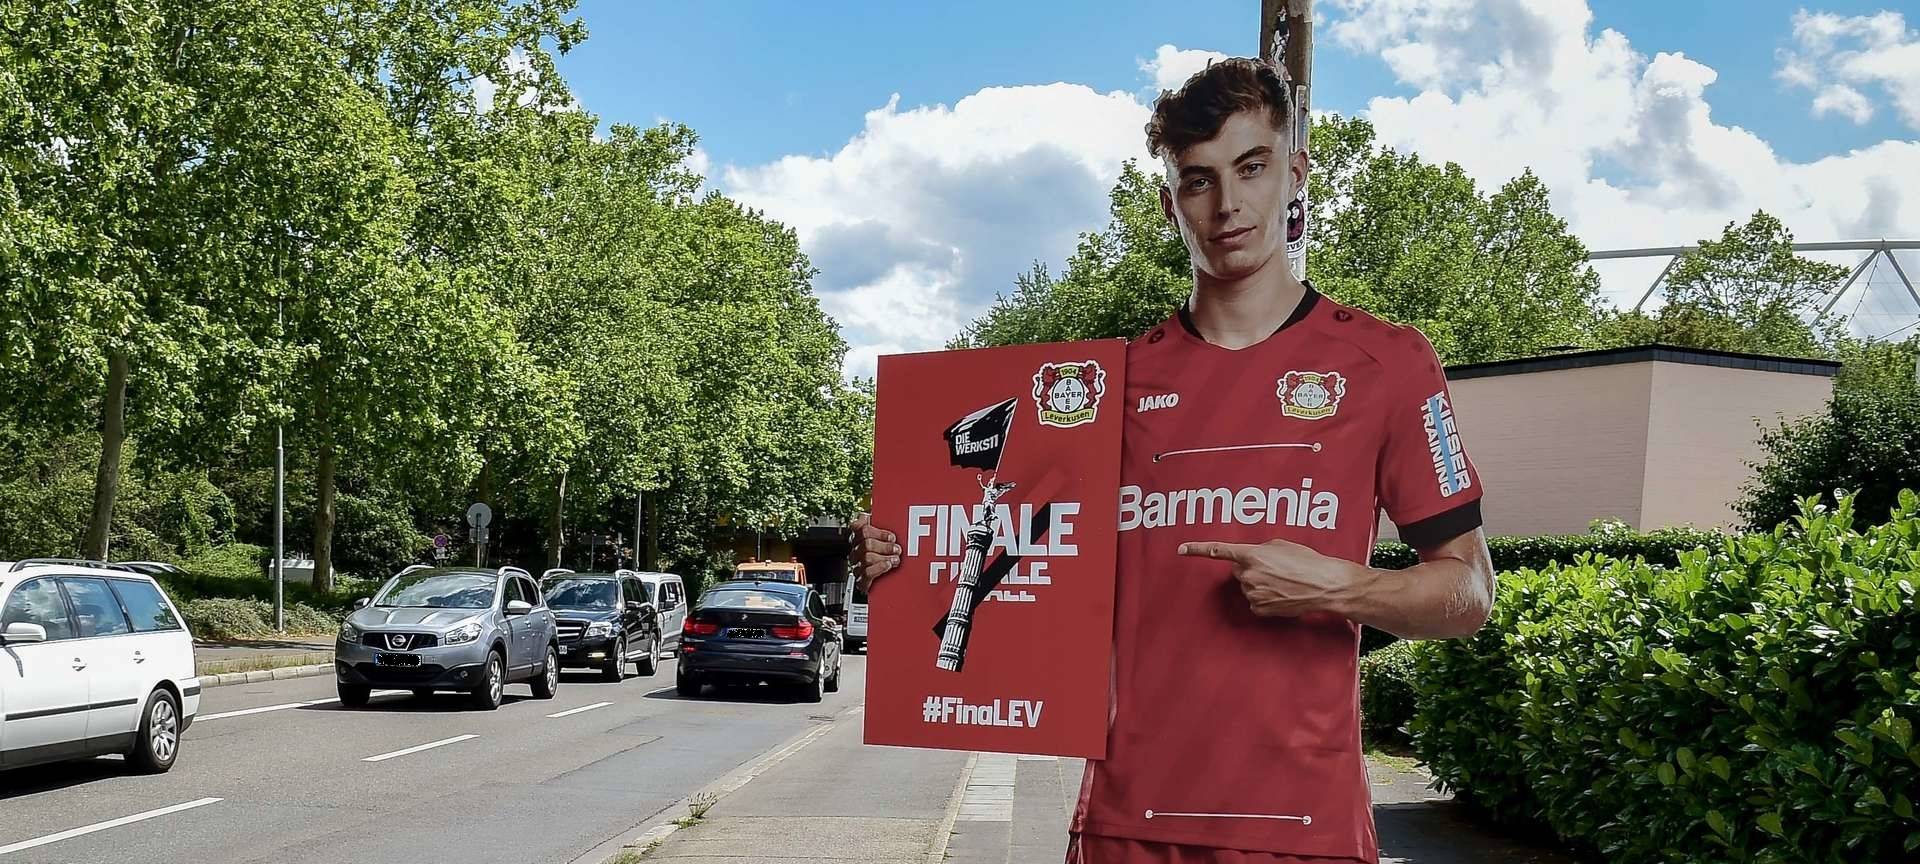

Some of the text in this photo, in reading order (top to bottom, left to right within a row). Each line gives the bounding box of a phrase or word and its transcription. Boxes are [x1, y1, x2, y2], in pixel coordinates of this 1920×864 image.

[1054, 391, 1082, 399] BAYER
[1137, 393, 1179, 413] JAKO
[1044, 411, 1090, 423] Leverkusen
[1287, 406, 1331, 415] Leverkusen
[955, 431, 970, 445] DIE
[1420, 399, 1452, 498] TRAINING
[1436, 391, 1472, 491] KIESER
[1117, 477, 1339, 531] Barmenia
[907, 502, 1081, 557] FINALE
[922, 696, 1043, 728] #FinaLEV
